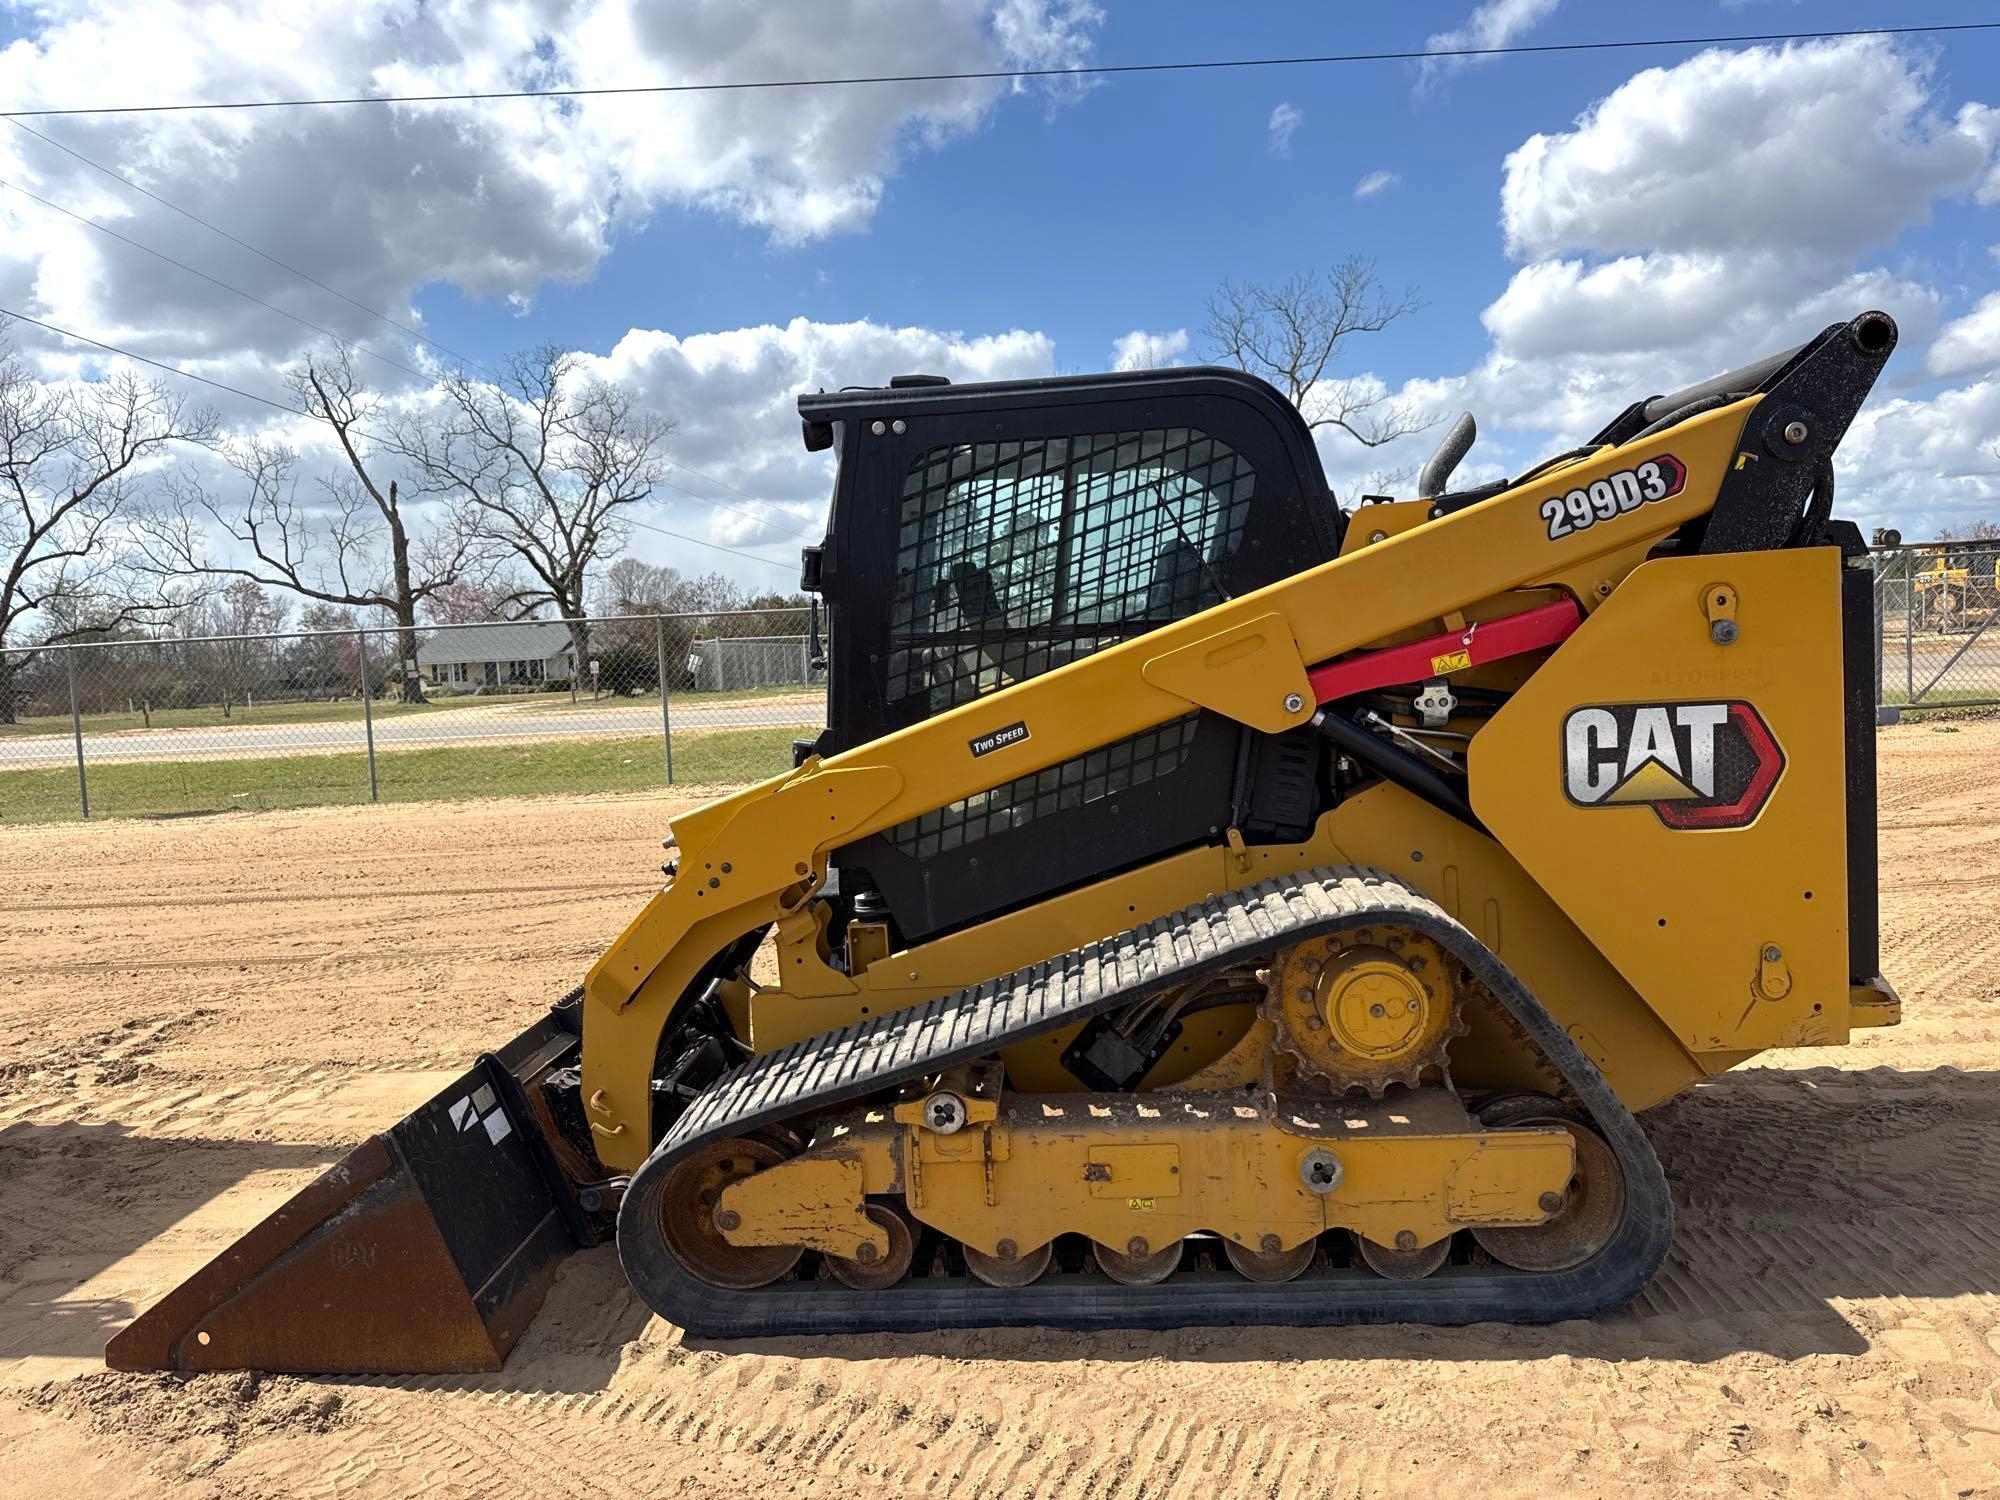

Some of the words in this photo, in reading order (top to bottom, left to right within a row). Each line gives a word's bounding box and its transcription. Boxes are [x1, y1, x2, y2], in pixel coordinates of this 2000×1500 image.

[1541, 462, 1667, 539] 299D3
[973, 739, 994, 753] TWO
[995, 727, 1024, 745] SPEED
[1566, 704, 1728, 803] CAT
